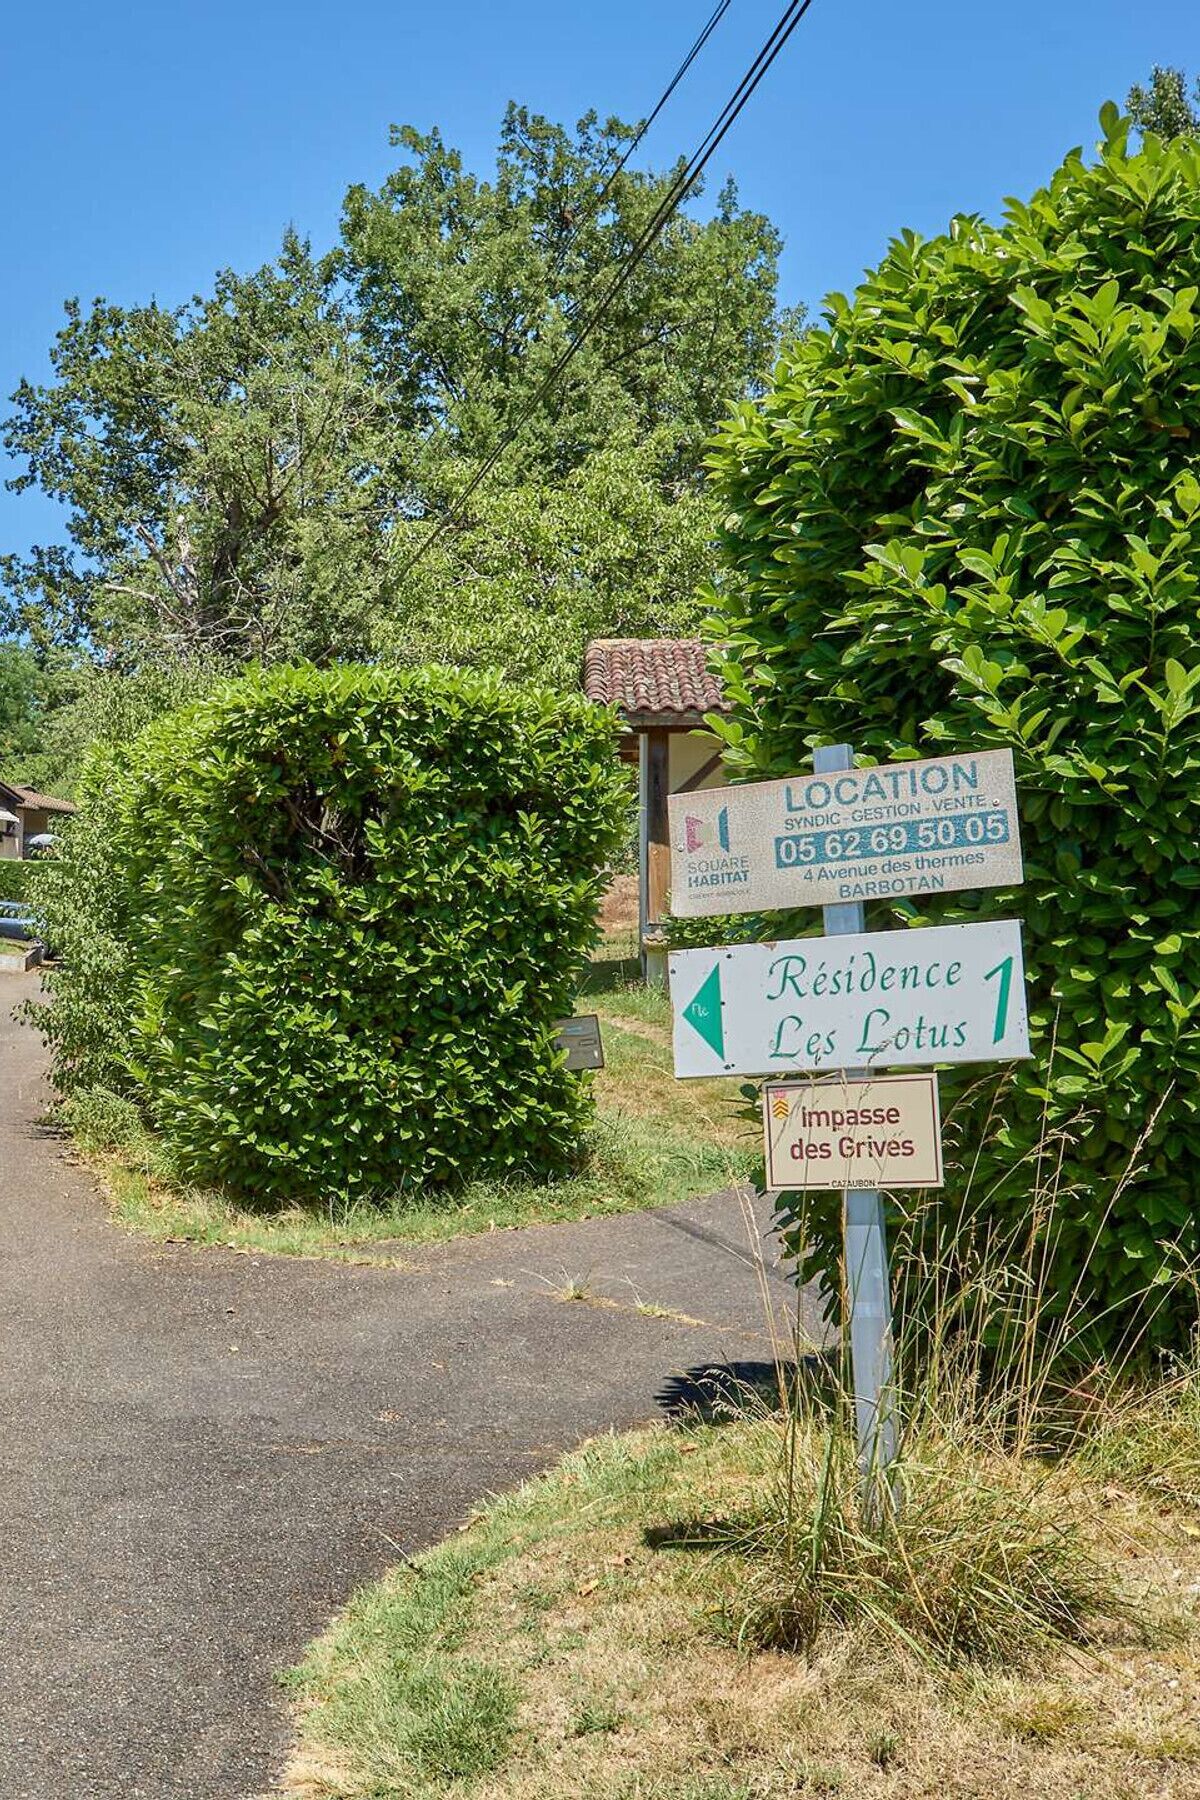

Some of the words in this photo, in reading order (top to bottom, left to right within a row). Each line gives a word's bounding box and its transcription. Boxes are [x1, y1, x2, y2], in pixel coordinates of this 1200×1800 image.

[784, 761, 978, 813] LOCATION
[784, 812, 841, 831] SYNDIC
[851, 802, 921, 823] GESTION
[932, 794, 987, 812] VENTE
[779, 837, 816, 864] 05
[825, 832, 861, 858] 62
[871, 825, 907, 853] 69
[918, 820, 955, 848] 50
[965, 814, 1004, 843] 05
[688, 869, 749, 888] HABITAT
[803, 869, 813, 882] 4
[817, 864, 876, 881] Avenue
[881, 858, 911, 874] des
[914, 852, 985, 871] thermes
[839, 874, 944, 899] BARBOTAN
[766, 952, 962, 1001] Résidence
[984, 956, 1014, 1045] 1
[769, 1015, 837, 1059] Les
[856, 1008, 968, 1054] Lotus
[790, 1138, 832, 1160] des
[839, 1135, 915, 1160] Grives
